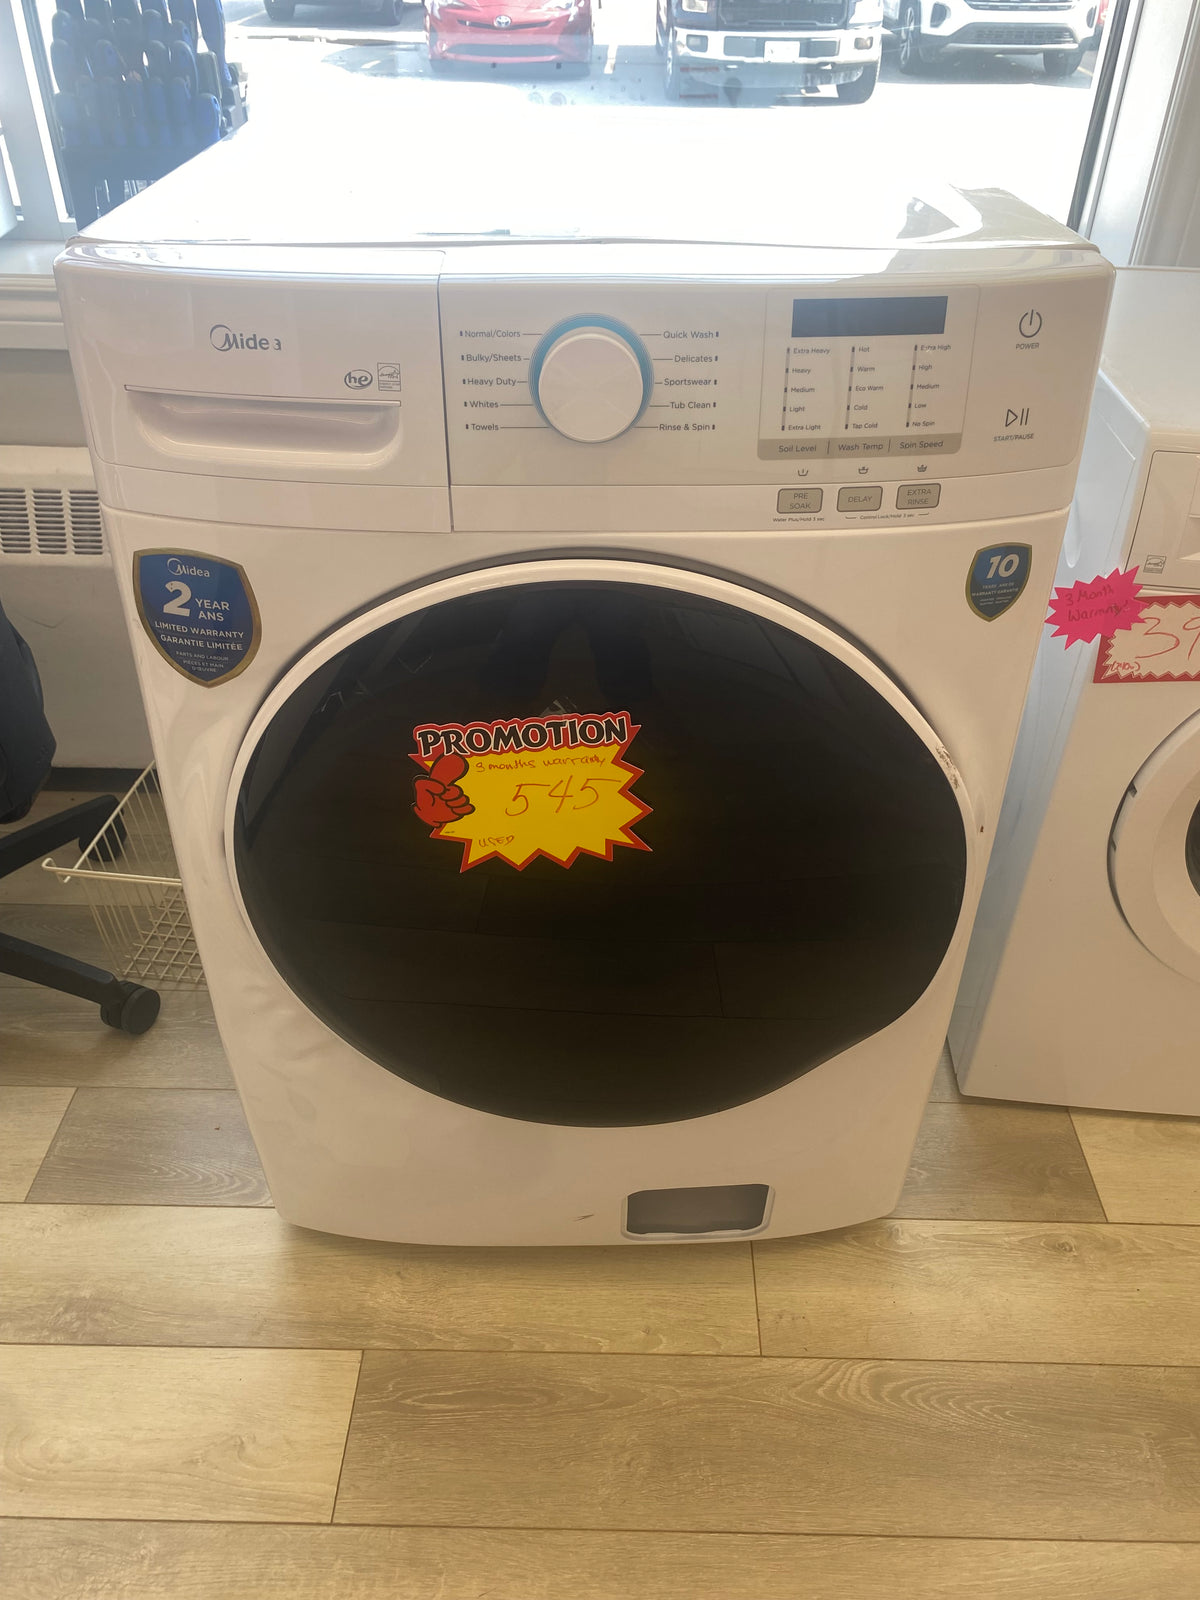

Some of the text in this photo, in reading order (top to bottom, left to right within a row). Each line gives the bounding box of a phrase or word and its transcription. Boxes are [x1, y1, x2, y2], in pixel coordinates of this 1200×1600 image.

[464, 329, 521, 338] Normal/Colors
[663, 330, 714, 339] Quick Wash
[1015, 342, 1040, 350] POWER
[811, 347, 831, 355] Heavy
[466, 353, 522, 362] Bulky/Sheets
[674, 354, 713, 363] Delicates
[791, 367, 811, 375] Heavy
[918, 364, 933, 372] High
[467, 376, 517, 387] Heavy Duty
[664, 378, 712, 387] Sportswear
[469, 400, 499, 409] Whites
[669, 401, 711, 409] Tub Clean
[789, 405, 805, 413] Light
[471, 423, 500, 432] Towels
[659, 423, 711, 432] Rinse & Spin
[805, 424, 821, 432] Light
[922, 420, 936, 428] Spin
[993, 433, 1035, 442] START/PAUSE
[838, 442, 884, 452] Wash Temp
[899, 439, 944, 450] Spin Speed
[778, 445, 817, 454] Soil Level
[793, 492, 809, 500] PRE
[907, 488, 932, 497] EXTRA
[848, 495, 873, 504] DELAY
[907, 498, 930, 506] RINSE
[789, 502, 812, 510] SOAK
[167, 557, 211, 578] Midea
[987, 553, 1020, 579] 10
[163, 581, 230, 617] 2 YEAR
[1065, 584, 1114, 607] 3 Month
[198, 610, 224, 622] ANS
[154, 621, 244, 639] LIMITED WARRANTY
[160, 634, 244, 651] GARANTIE LIMITÉE
[417, 715, 628, 757] PROMOTION
[488, 759, 536, 771] months
[543, 754, 606, 768] warranty
[504, 774, 622, 817] 545
[478, 834, 515, 848] USED
